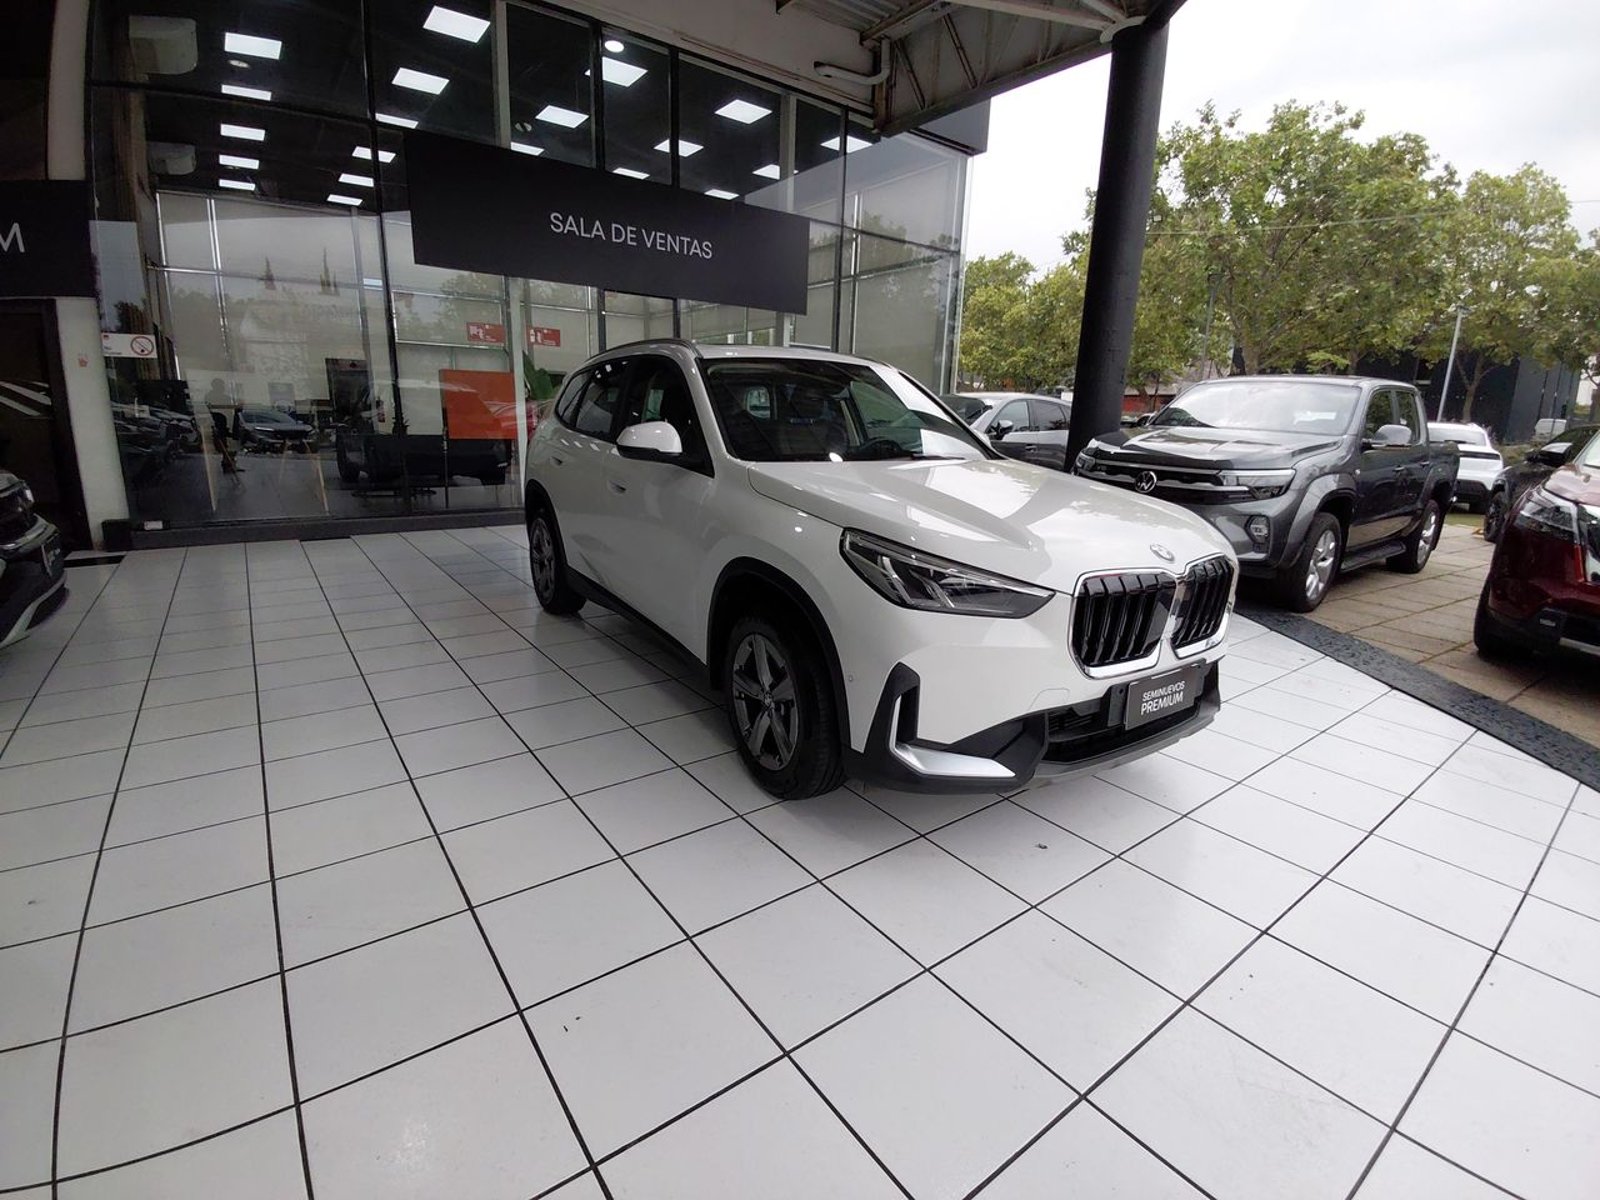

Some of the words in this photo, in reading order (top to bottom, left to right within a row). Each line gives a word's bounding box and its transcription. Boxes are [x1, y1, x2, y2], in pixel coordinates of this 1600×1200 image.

[550, 212, 606, 241] SALA
[611, 223, 637, 246] DE
[642, 229, 713, 259] VENTAS
[1140, 691, 1184, 716] PREMIUM
[1142, 680, 1185, 702] SEMINUEVOS
